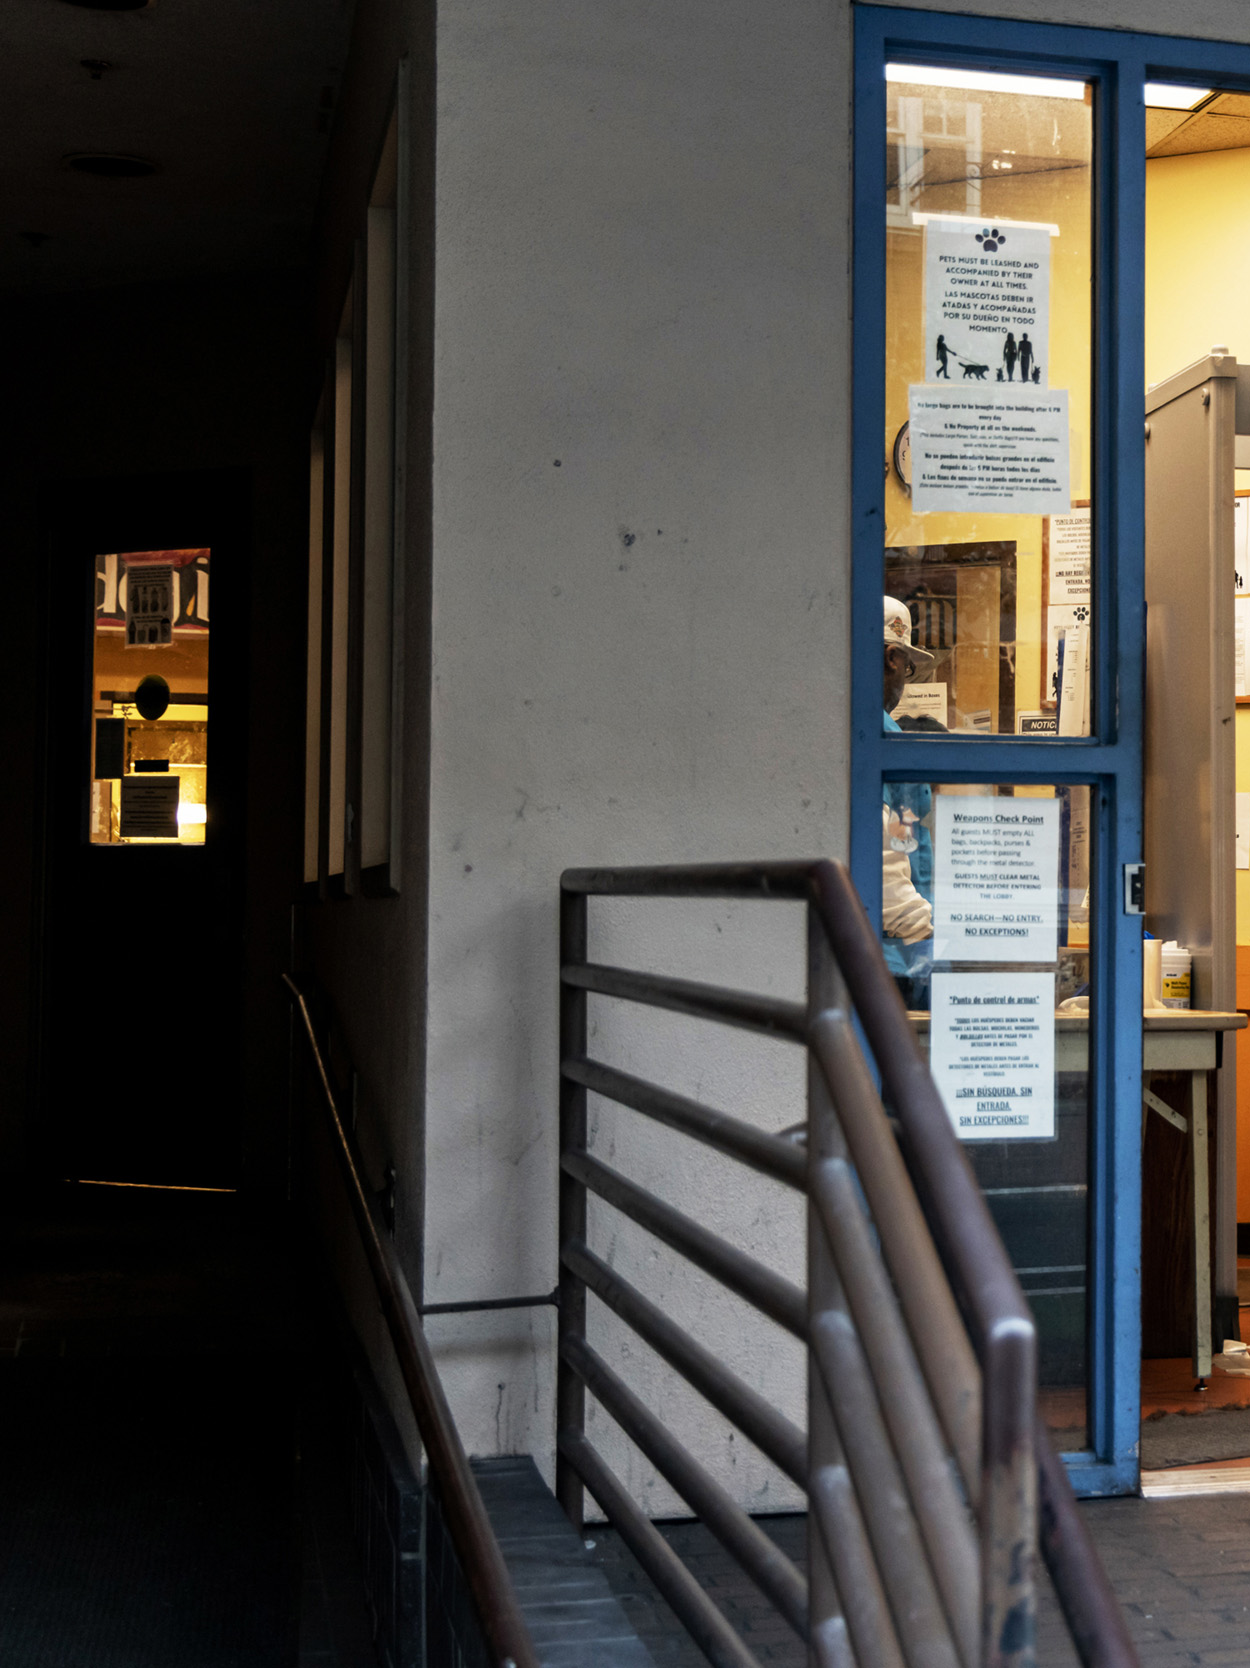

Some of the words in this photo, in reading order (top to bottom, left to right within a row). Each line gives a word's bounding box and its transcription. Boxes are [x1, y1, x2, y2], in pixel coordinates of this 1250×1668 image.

[946, 268, 999, 276] ACCOMPANIED
[961, 292, 999, 300] MASCOTAS
[981, 304, 1035, 314] ACOMPAÑADAS
[954, 814, 992, 823] Weapons
[1021, 1087, 1032, 1096] SIN
[960, 1116, 971, 1126] SIN
